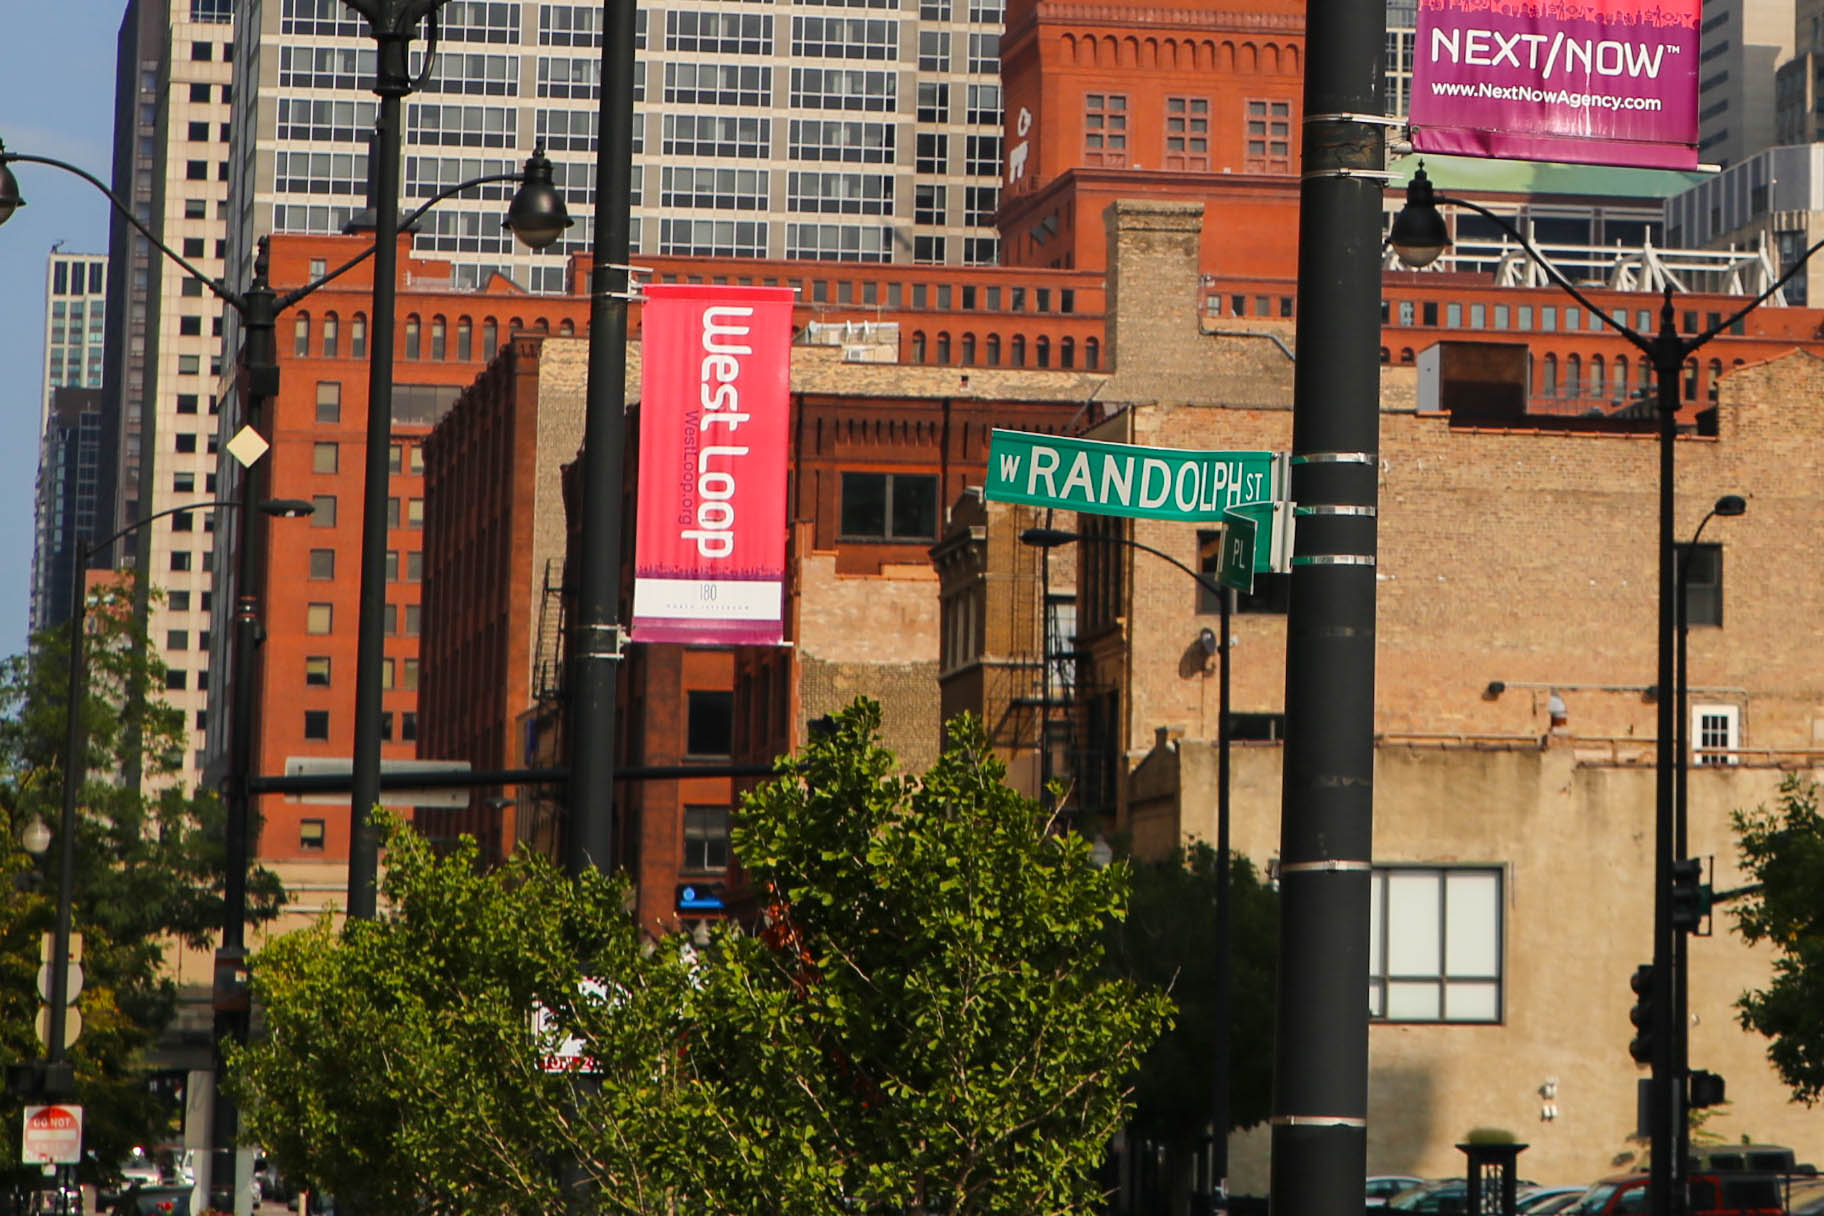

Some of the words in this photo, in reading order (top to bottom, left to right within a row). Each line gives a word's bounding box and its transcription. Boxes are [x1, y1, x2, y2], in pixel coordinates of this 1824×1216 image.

[1431, 82, 1662, 112] www.NextNowAgency.com
[701, 306, 754, 432] West
[678, 410, 699, 526] WestLoop.org
[681, 446, 750, 558] Loop
[1000, 453, 1021, 483] W
[1027, 445, 1243, 513] RANDOLPH
[1245, 472, 1264, 502] ST
